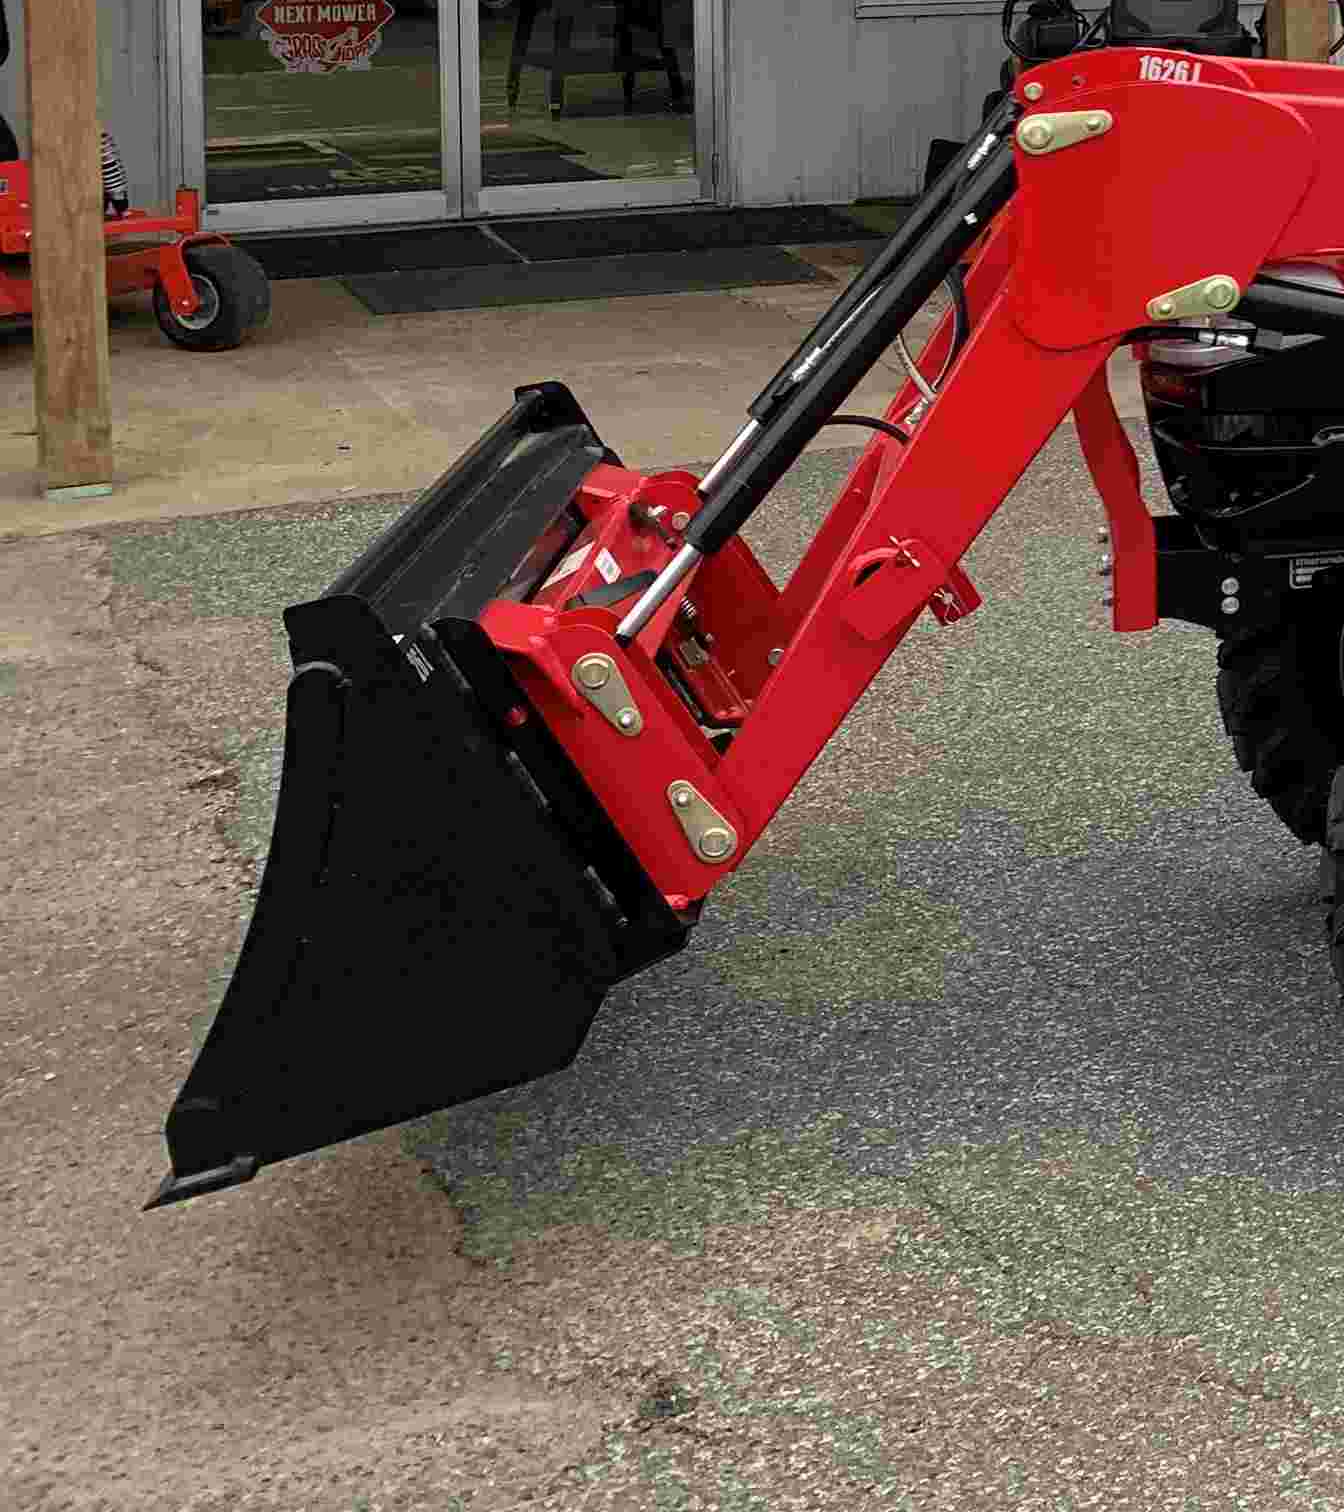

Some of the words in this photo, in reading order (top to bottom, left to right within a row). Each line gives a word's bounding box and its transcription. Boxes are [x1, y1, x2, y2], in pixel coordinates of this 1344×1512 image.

[273, 5, 315, 24] NEXT
[317, 3, 376, 22] MOWER
[1139, 55, 1190, 81] 1626
